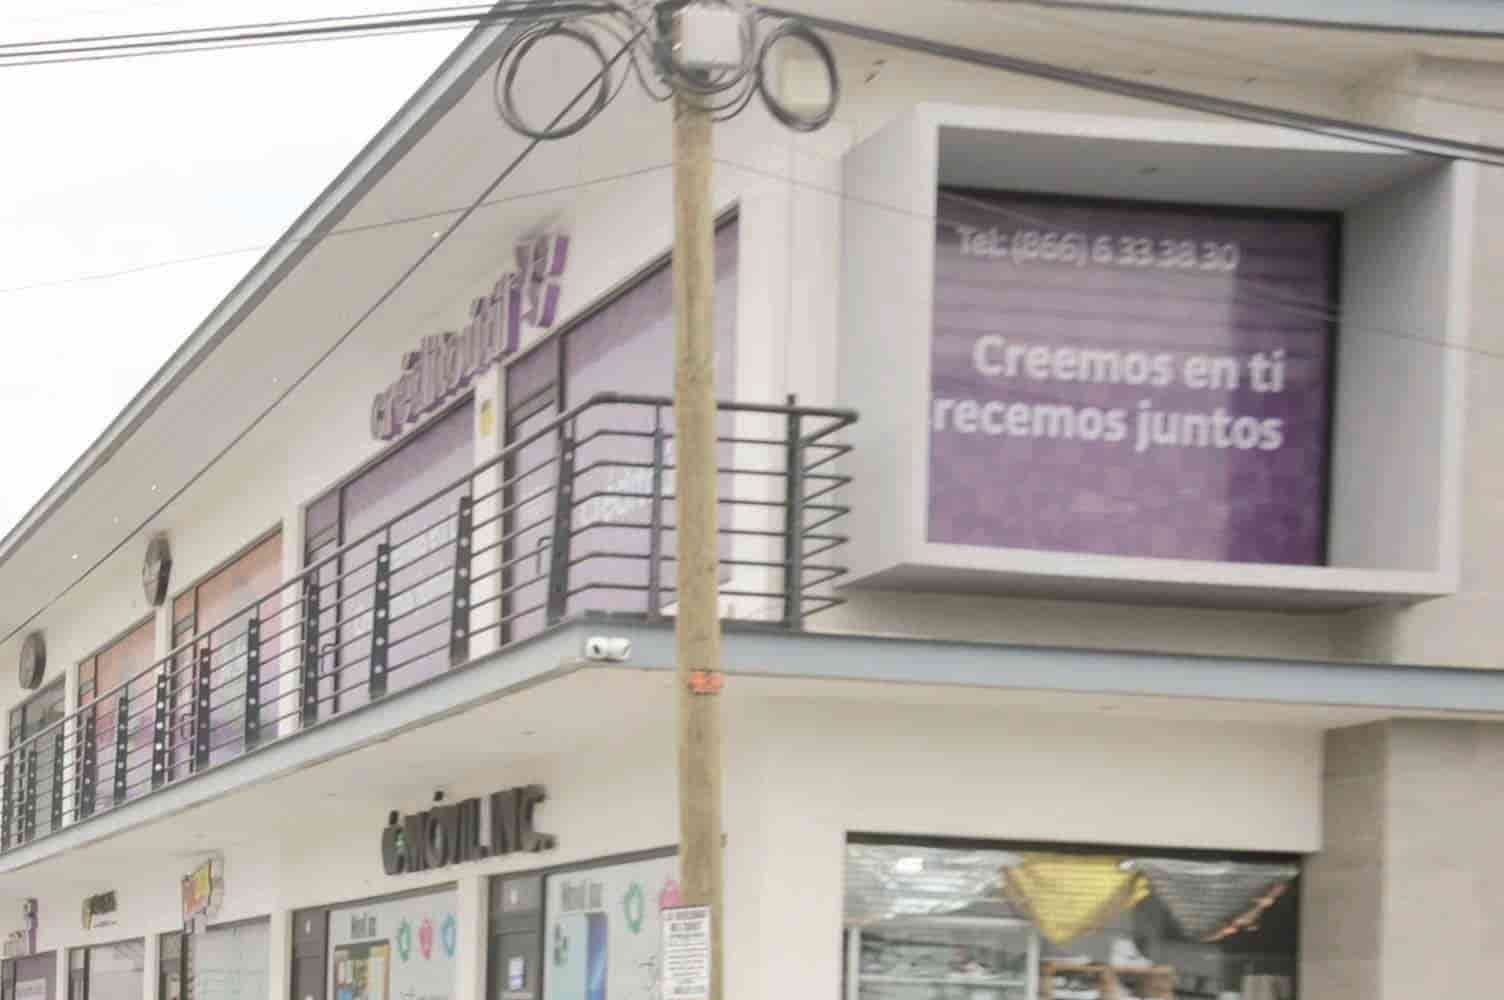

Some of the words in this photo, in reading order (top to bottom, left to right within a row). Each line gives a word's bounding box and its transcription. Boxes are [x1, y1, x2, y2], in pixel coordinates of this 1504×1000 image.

[972, 333, 1176, 387] Creemos
[1183, 353, 1240, 391] en
[1133, 399, 1285, 451] juntos
